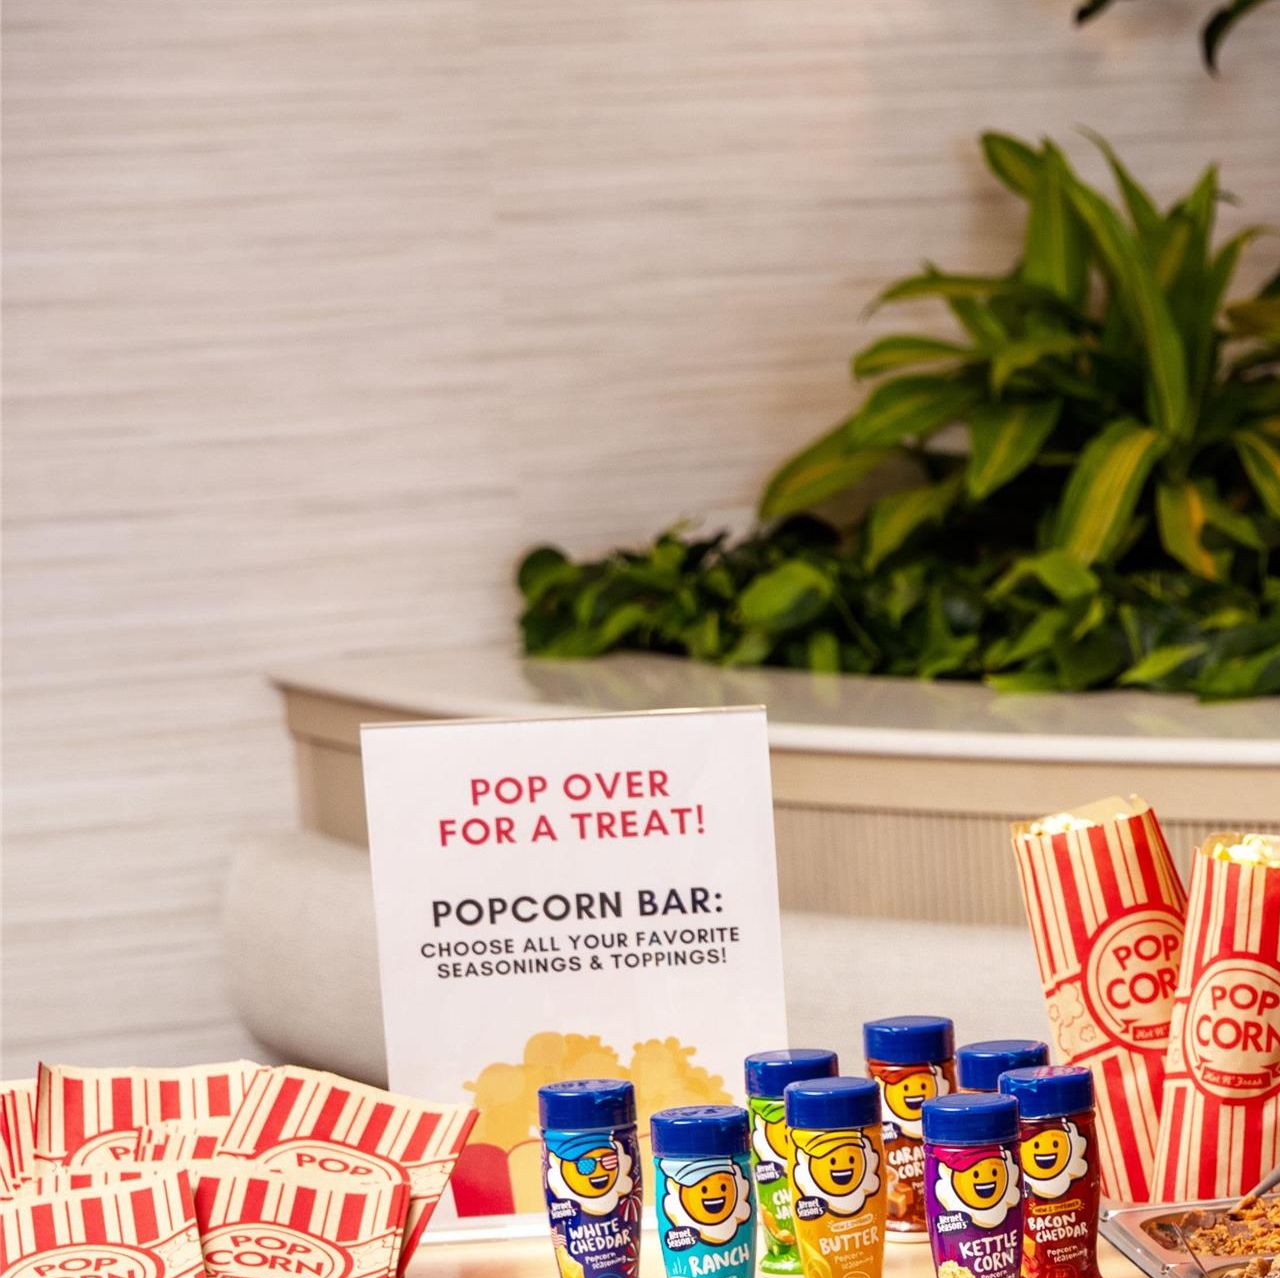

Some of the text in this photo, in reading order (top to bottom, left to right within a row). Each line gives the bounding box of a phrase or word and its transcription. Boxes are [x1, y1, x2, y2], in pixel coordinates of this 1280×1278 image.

[470, 769, 670, 806] POP OVER
[439, 804, 705, 847] FOR A TREAT!
[432, 886, 724, 928] POPCORN BAR:
[420, 926, 741, 959] CHOOSE ALL YOUR FAVORITE
[1112, 934, 1179, 971] POP
[437, 947, 727, 980] SEASONINGS & TOPPINGS!
[1106, 967, 1178, 1010] COR
[1211, 983, 1280, 1016] POP
[296, 1152, 373, 1176] POP
[888, 1146, 924, 1165] CARA
[899, 1161, 924, 1180] COR
[568, 1217, 620, 1240] WHITE
[1027, 1212, 1076, 1231] BACON
[1035, 1222, 1088, 1243] CHEDDAR
[230, 1235, 312, 1255] POP
[570, 1228, 631, 1255] CHEDDAR
[818, 1225, 880, 1256] BUTTER
[958, 1229, 1018, 1259] KETTLE
[33, 1257, 119, 1277] POP
[204, 1249, 324, 1277] CORN
[688, 1243, 750, 1278] RANCH
[973, 1248, 1015, 1273] CORN
